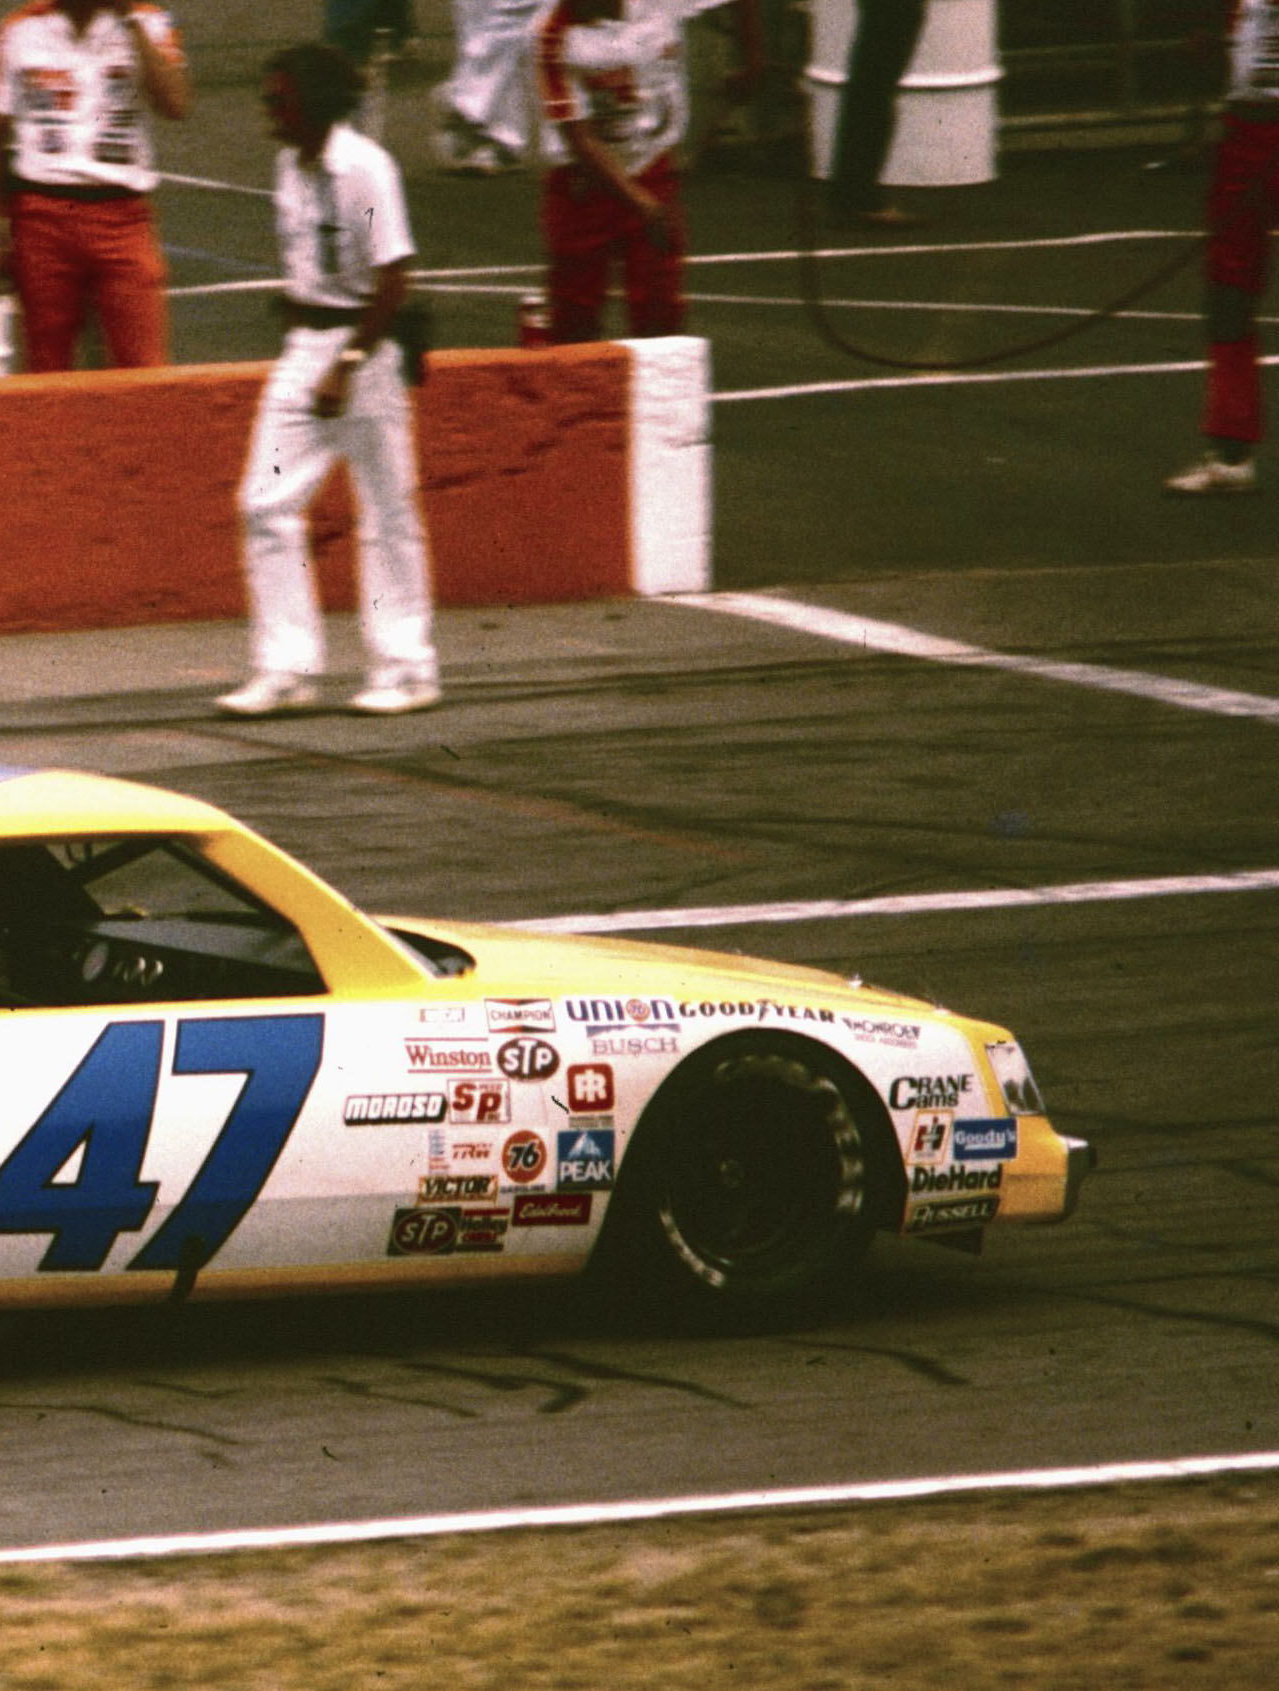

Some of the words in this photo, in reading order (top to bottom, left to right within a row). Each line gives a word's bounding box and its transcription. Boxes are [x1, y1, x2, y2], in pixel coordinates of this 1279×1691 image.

[491, 1009, 552, 1022] CHAMPION
[679, 999, 837, 1024] GOODYEAR
[405, 1044, 492, 1068] Winston
[503, 1040, 553, 1075] STP
[592, 1036, 679, 1055] BUSCH
[344, 1094, 443, 1121] MOROSO
[955, 1128, 1016, 1147] Goody's
[507, 1142, 539, 1171] 76
[559, 1159, 611, 1183] PEAK
[912, 1163, 1002, 1190] DieHard
[424, 1176, 491, 1195] VICTOR
[401, 1213, 449, 1246] STP
